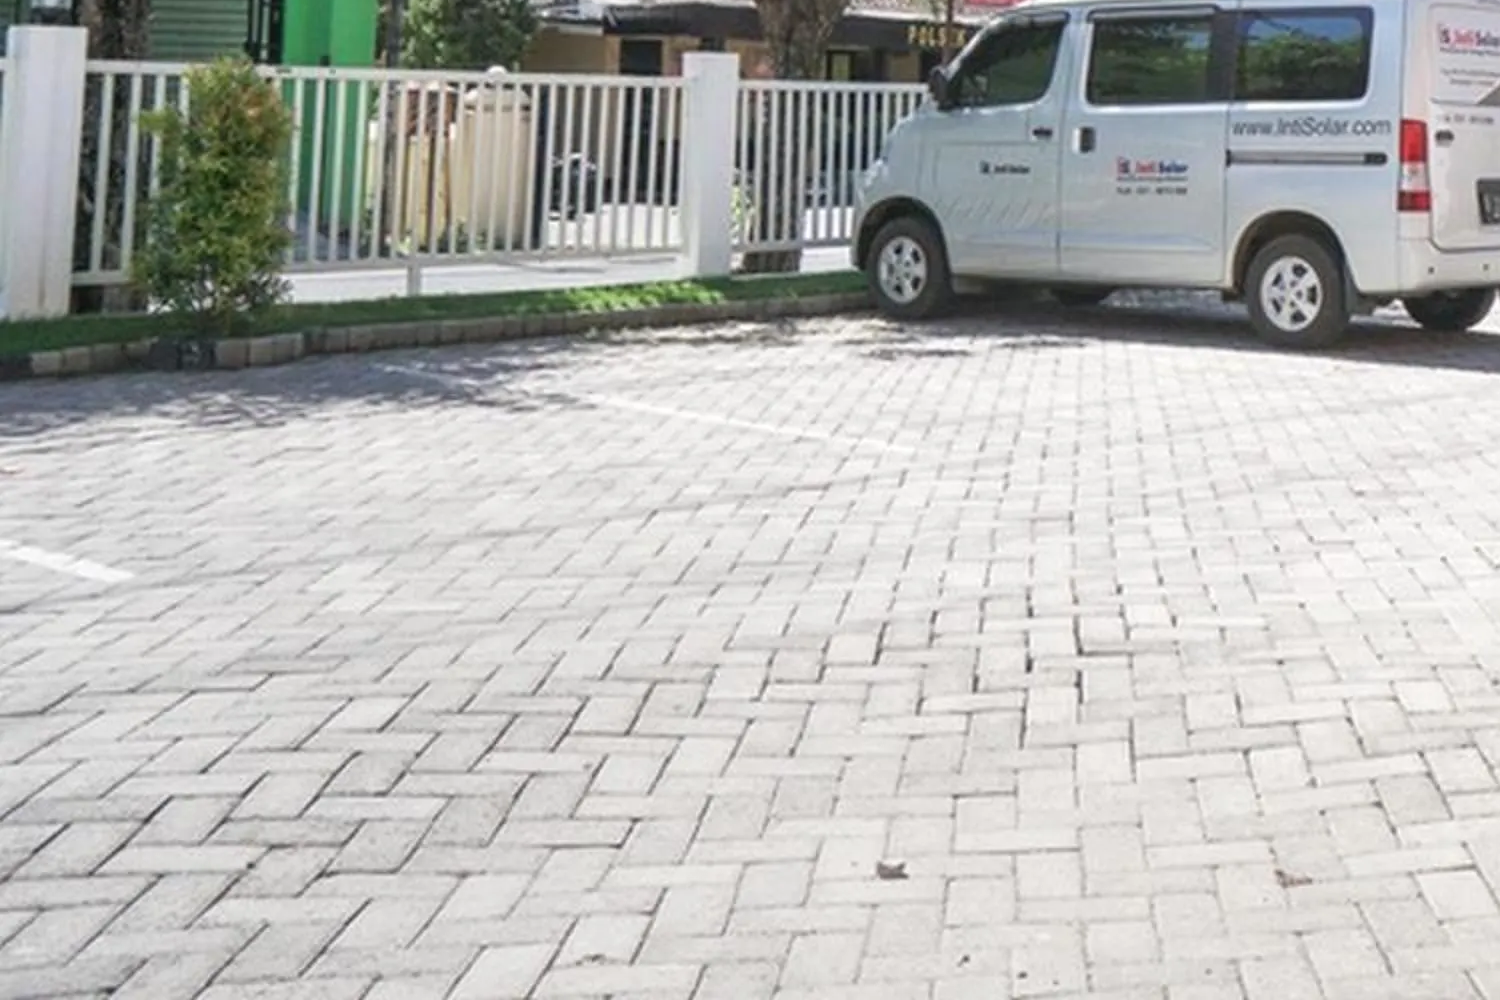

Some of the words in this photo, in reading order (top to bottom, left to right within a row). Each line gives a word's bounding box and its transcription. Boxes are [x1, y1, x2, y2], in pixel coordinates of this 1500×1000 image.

[907, 25, 966, 47] POLSK
[1232, 116, 1391, 136] www.IntiSolar.com
[1158, 160, 1188, 174] Solar
